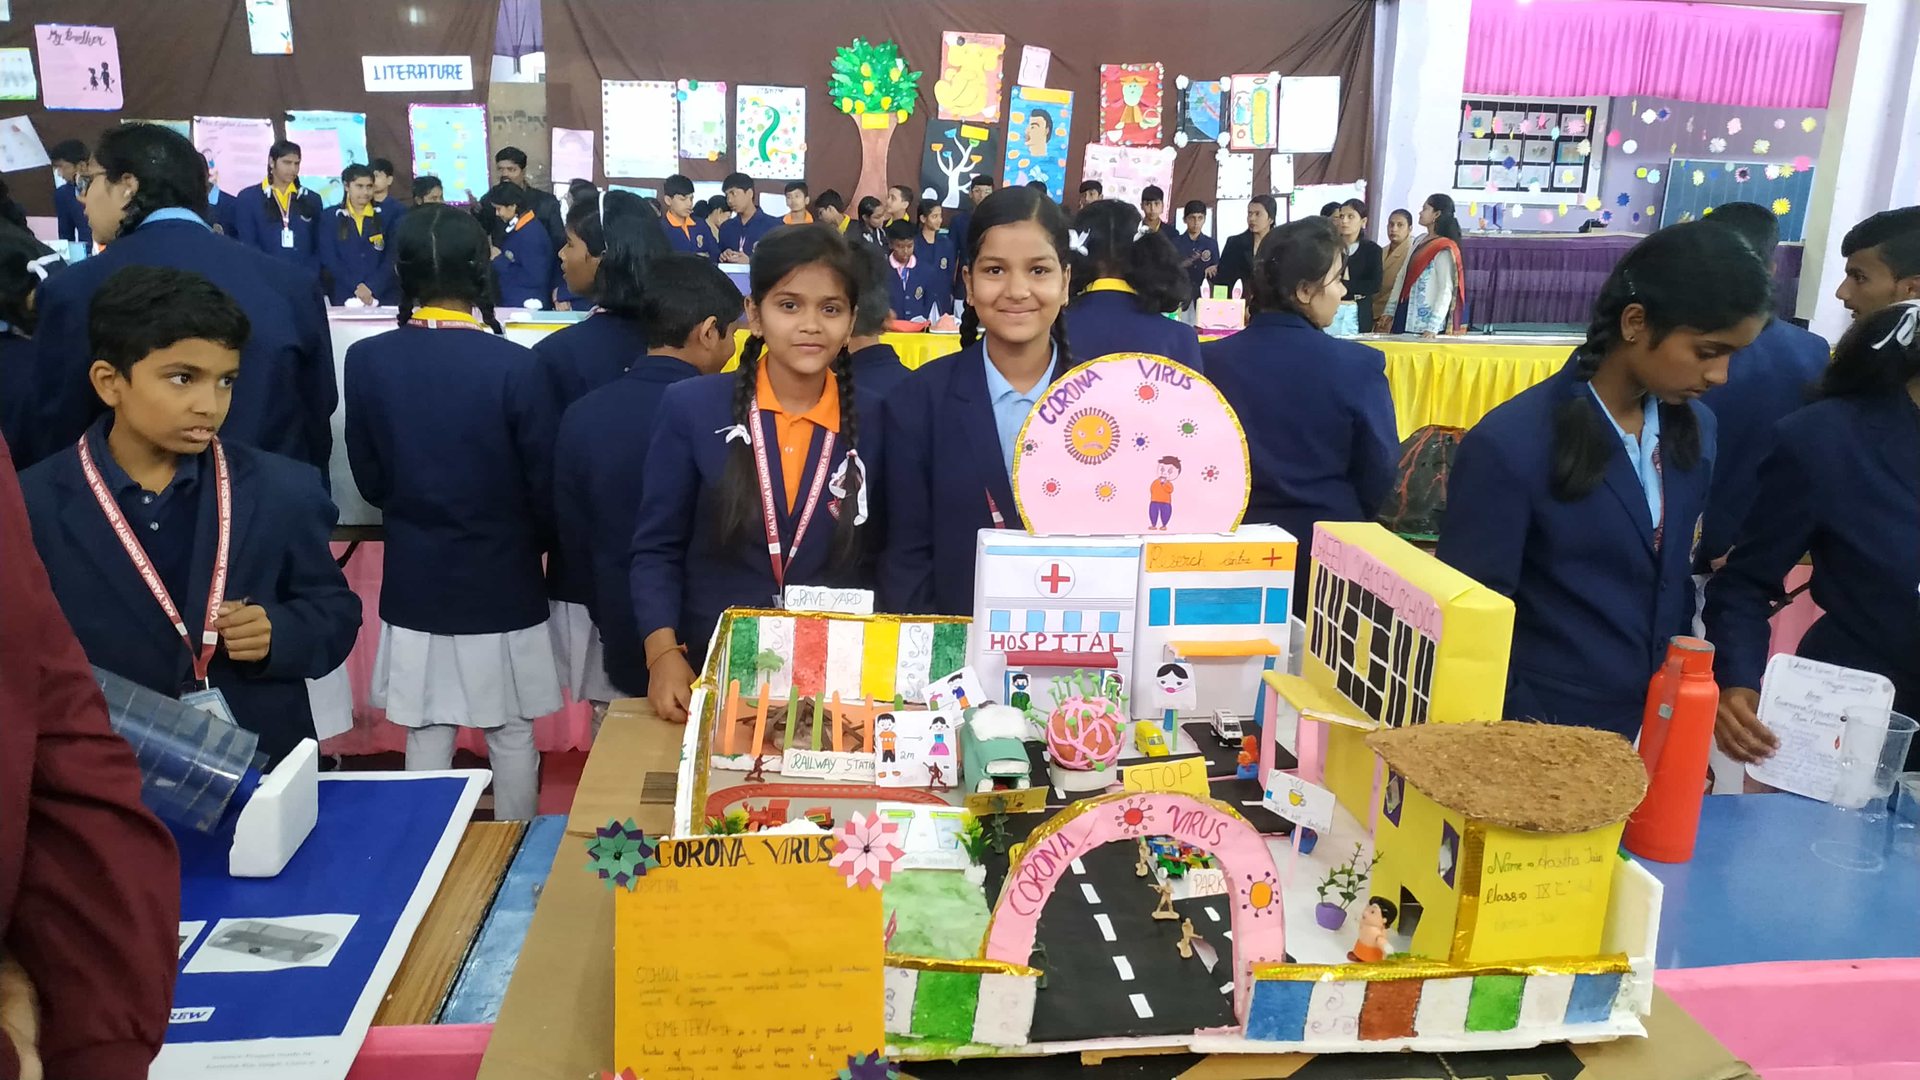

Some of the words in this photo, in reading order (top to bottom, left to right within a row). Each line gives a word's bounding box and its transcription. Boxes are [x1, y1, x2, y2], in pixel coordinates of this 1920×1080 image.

[373, 64, 463, 80] LITERATURE
[1038, 369, 1103, 425] CORONA
[1137, 359, 1194, 391] VIRUS
[758, 447, 771, 490] KENDRIYA
[812, 458, 828, 497] KENDRIYA
[822, 431, 834, 458] SHIKS
[94, 482, 119, 523] SHIKSHA
[763, 491, 777, 537] KALYANIKA
[114, 518, 148, 567] KENDRIYA
[143, 566, 176, 618] KALYANIKA
[785, 586, 826, 607] GRAVE
[830, 591, 863, 609] YARD
[990, 632, 1123, 652] HOSPITAL
[791, 753, 837, 772] RAILWAY
[844, 755, 876, 772] STATIO
[1130, 762, 1193, 791] STOP
[970, 792, 1025, 809] STP
[655, 838, 755, 867] CORONA
[763, 836, 834, 865] VIRUS
[1009, 832, 1077, 917] CORONA
[1166, 804, 1229, 847] VIRUS
[1487, 851, 1522, 875] Name
[634, 878, 681, 894] OSPITAL
[634, 966, 680, 984] SCHOOL
[170, 1010, 207, 1020] REW
[645, 1019, 711, 1040] CEMETERY
